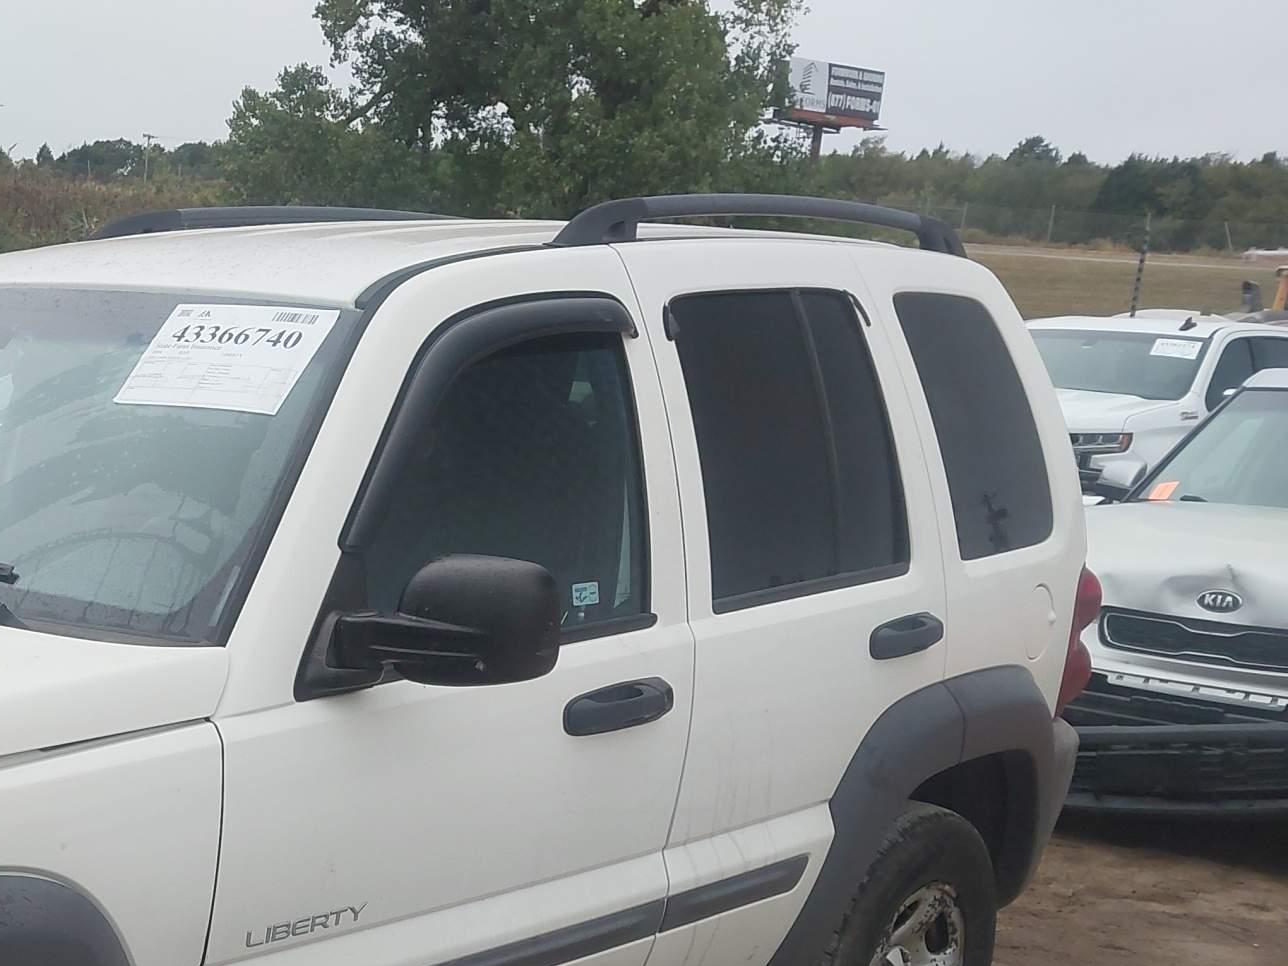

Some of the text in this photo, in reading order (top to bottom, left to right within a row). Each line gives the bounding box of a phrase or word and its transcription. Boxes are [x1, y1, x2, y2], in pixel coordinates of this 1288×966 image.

[172, 324, 303, 350] 43366740
[1204, 593, 1233, 608] KIA
[245, 901, 368, 948] LIBERTY
